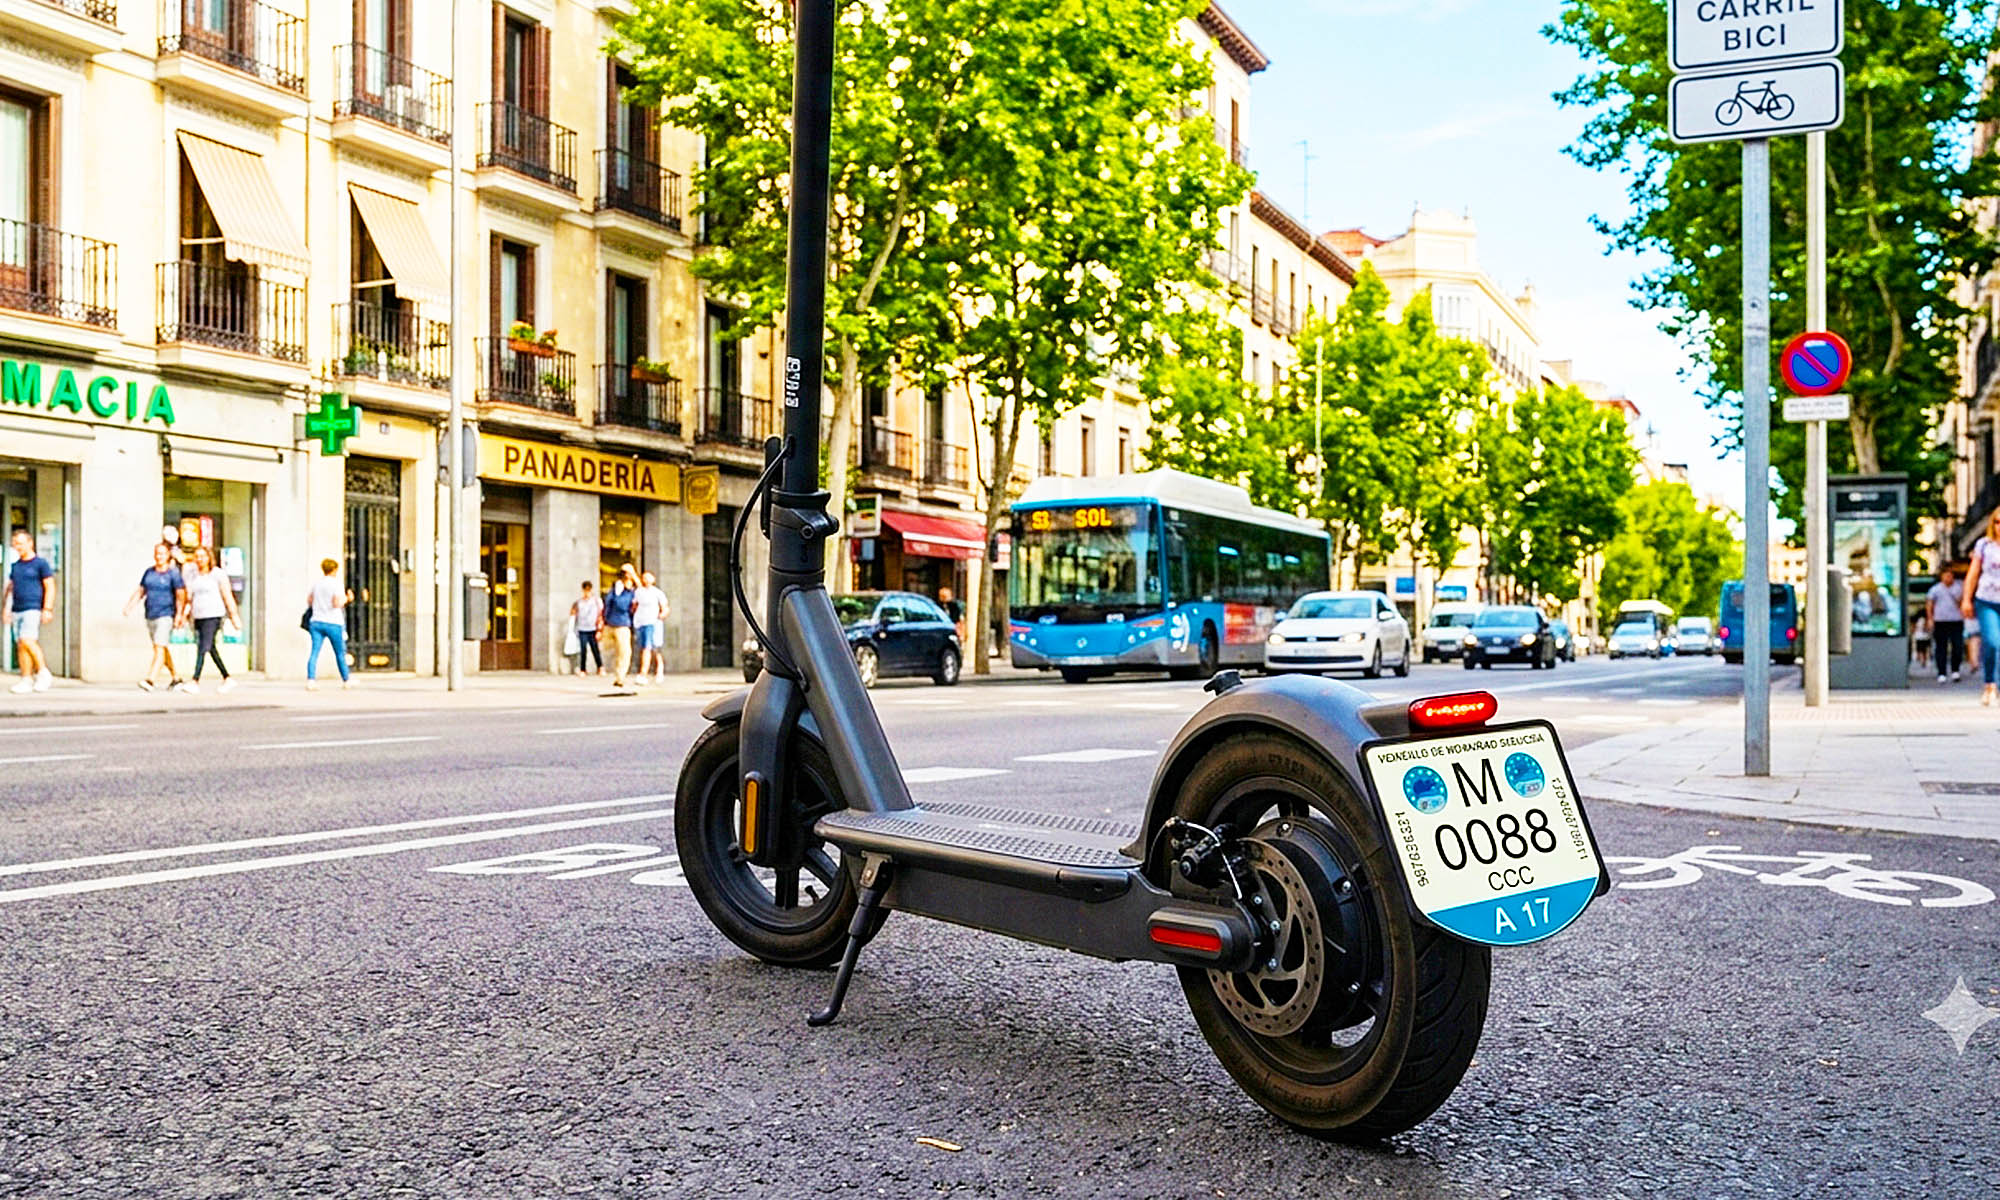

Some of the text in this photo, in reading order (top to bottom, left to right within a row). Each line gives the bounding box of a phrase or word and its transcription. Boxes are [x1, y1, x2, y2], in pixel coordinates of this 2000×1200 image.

[1697, 0, 1814, 22] CARRIL
[1724, 23, 1785, 51] BICI
[1, 360, 175, 427] MACIA
[504, 445, 655, 493] PANADERÍA
[1075, 508, 1112, 528] SOL
[1451, 758, 1503, 807] M
[1435, 808, 1556, 871] 0088
[1488, 865, 1535, 891] CCC
[1495, 897, 1550, 935] A 17
